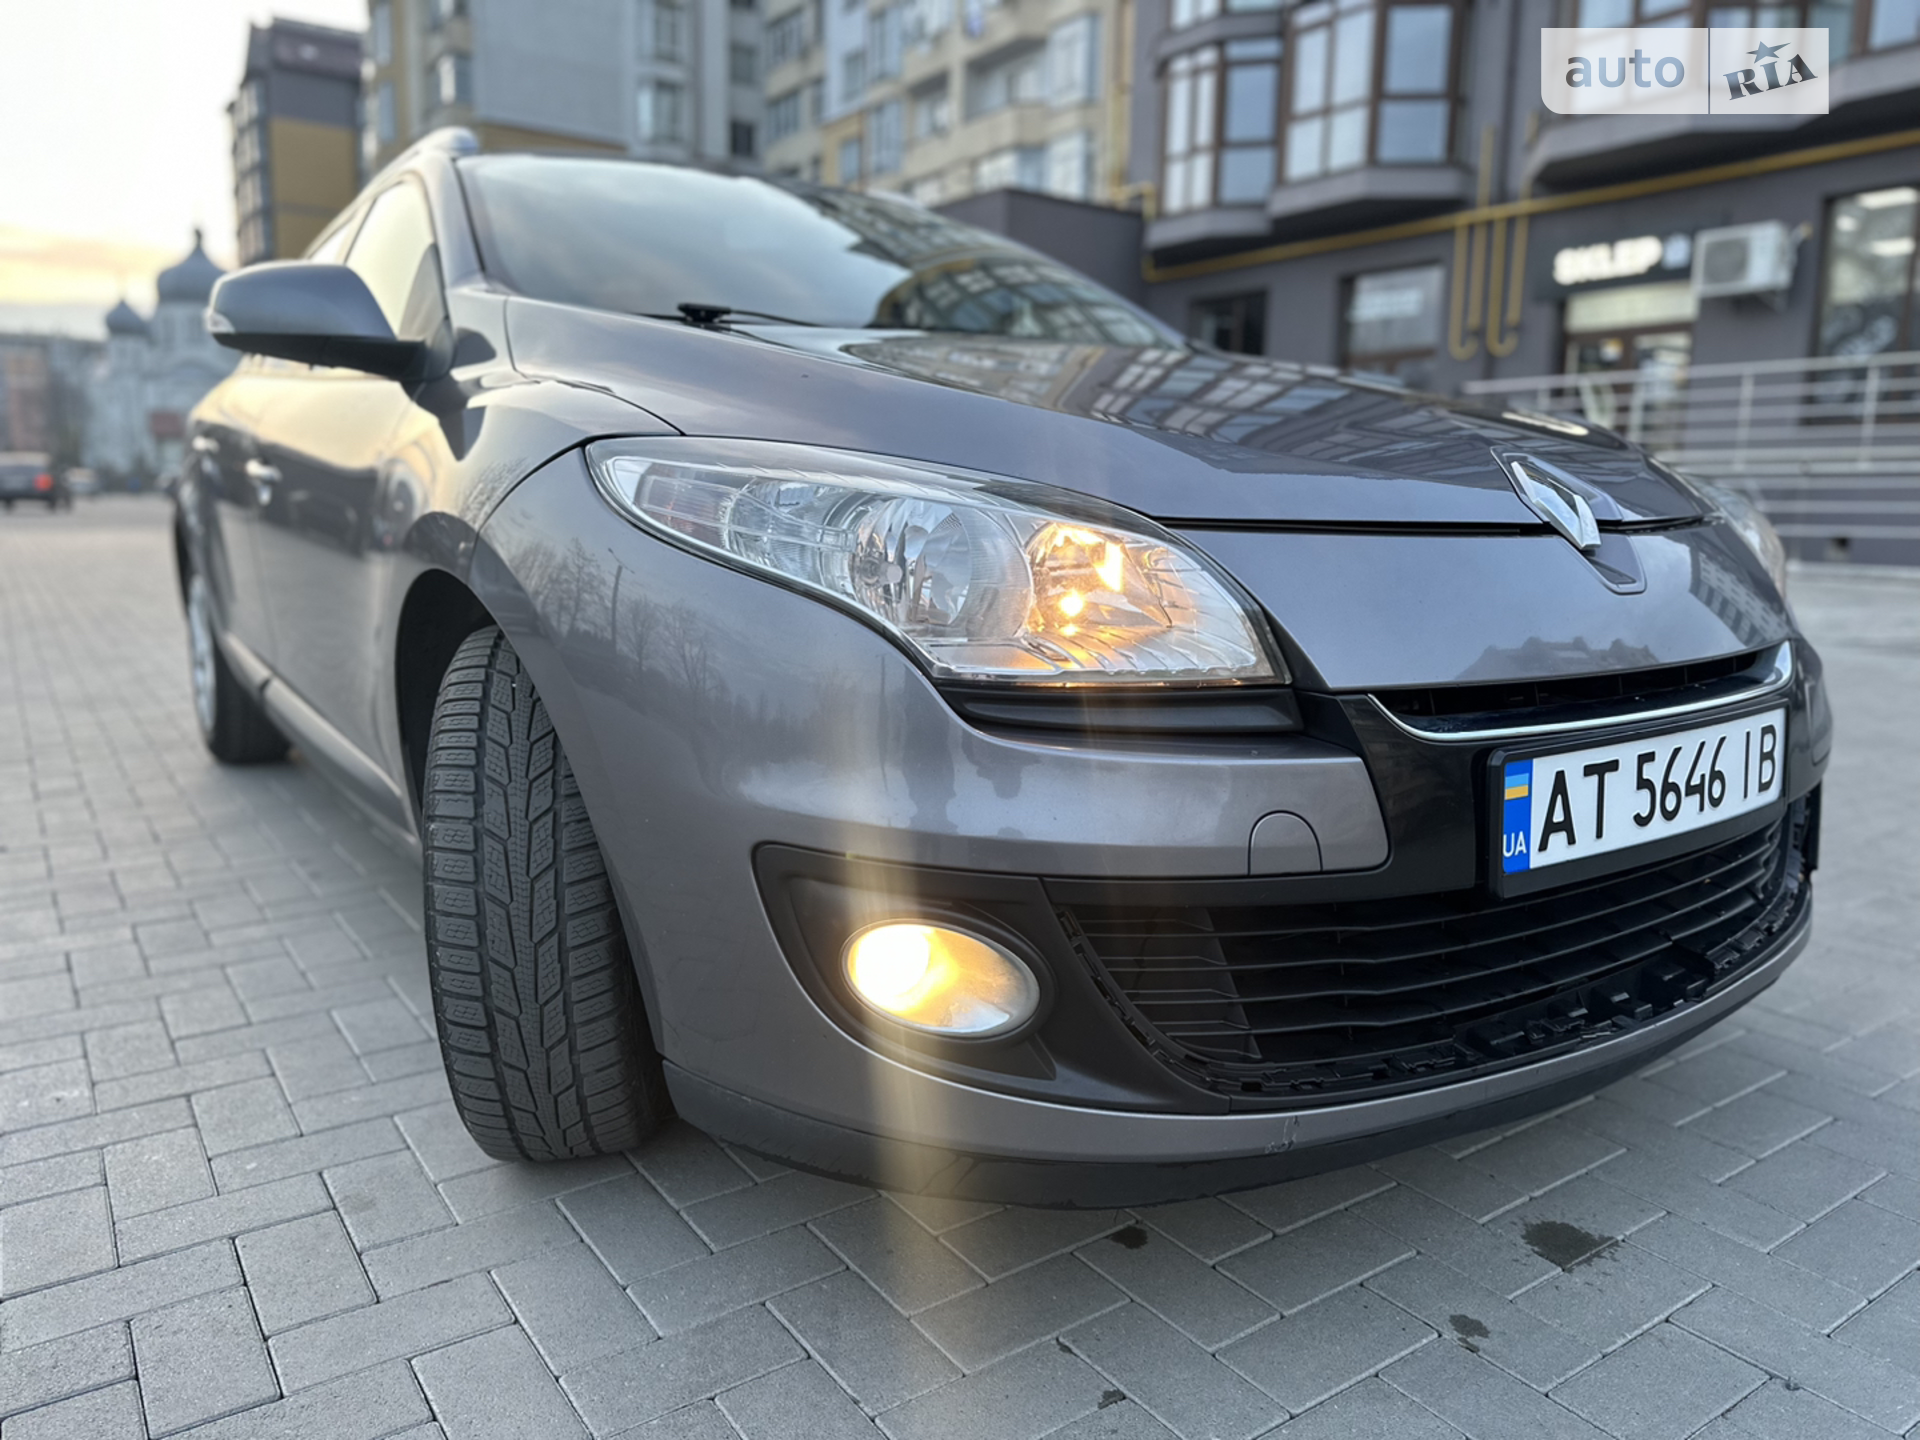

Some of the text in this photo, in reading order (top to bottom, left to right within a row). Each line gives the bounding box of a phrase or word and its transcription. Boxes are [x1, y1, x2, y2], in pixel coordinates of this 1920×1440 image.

[1537, 723, 1778, 853] AT 5646 IB
[1502, 830, 1528, 858] UA
